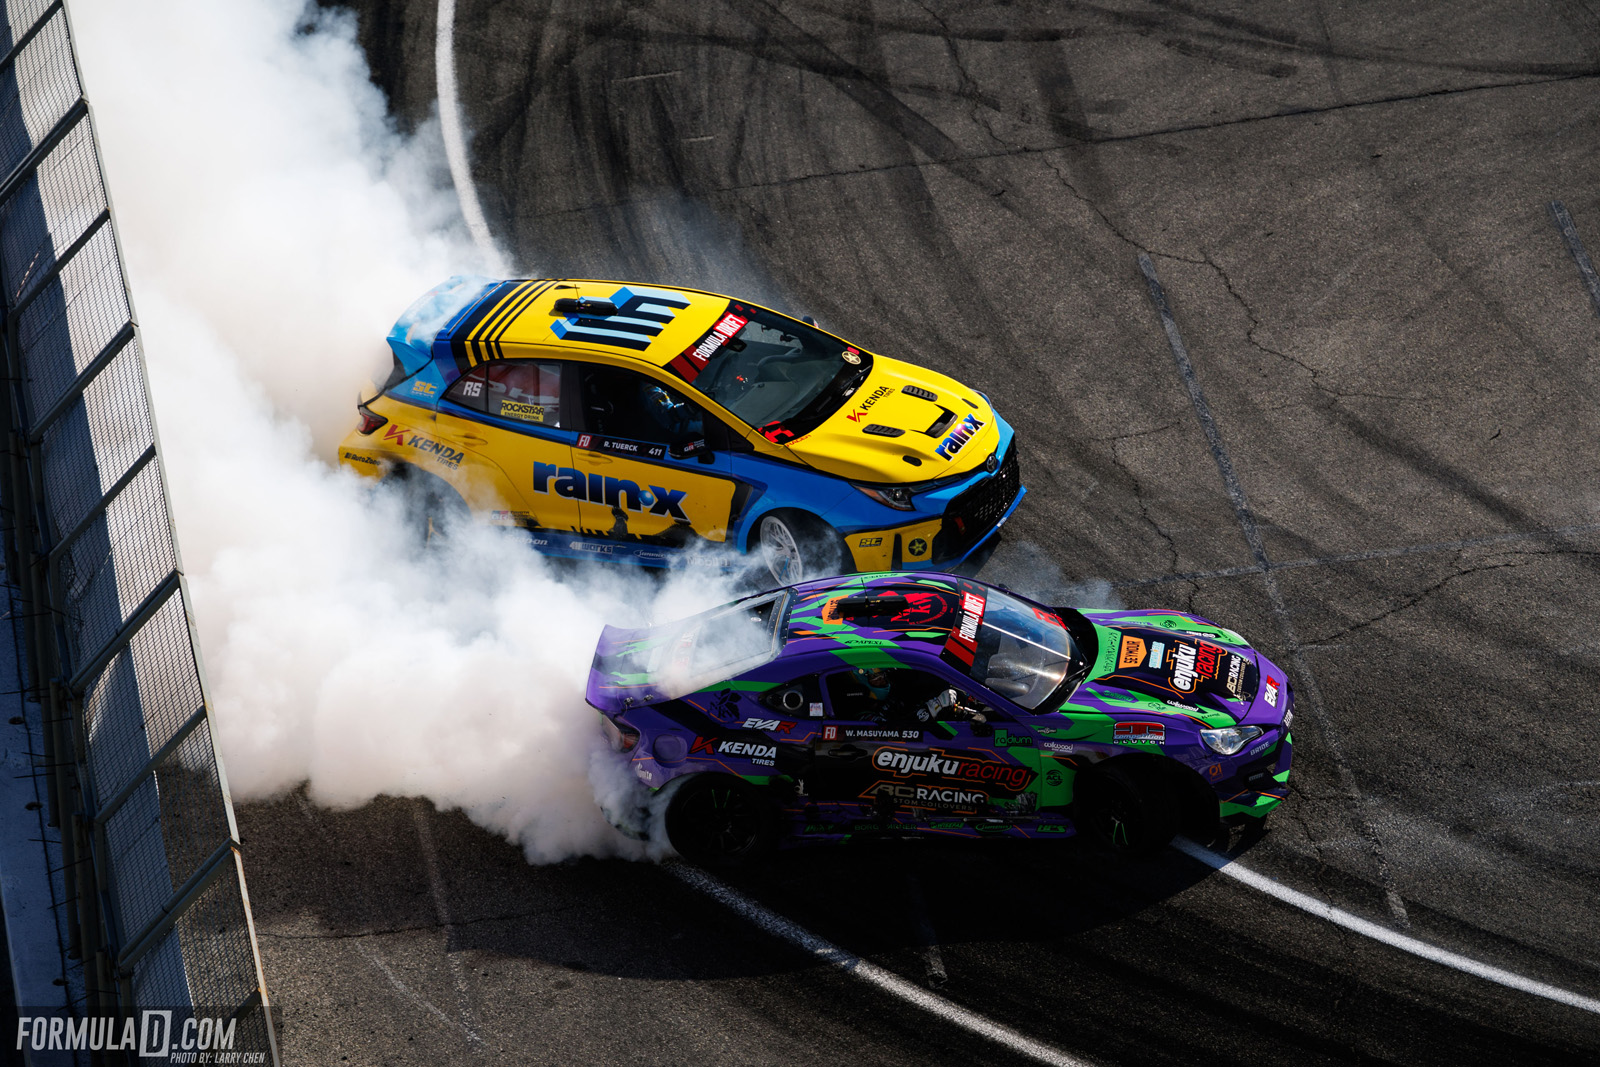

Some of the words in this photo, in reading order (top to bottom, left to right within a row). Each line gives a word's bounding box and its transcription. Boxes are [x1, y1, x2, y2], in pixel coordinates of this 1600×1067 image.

[692, 331, 728, 362] FORMULA
[715, 313, 745, 337] DRIFT
[463, 381, 483, 397] RS
[860, 386, 890, 411] KENDA
[501, 402, 545, 416] ROCKSTAR
[504, 412, 523, 420] ENERGY
[578, 434, 591, 447] FD
[407, 435, 465, 465] KENDA
[611, 442, 638, 452] TUERCK
[648, 447, 662, 456] 411
[436, 456, 459, 470] TIRES
[962, 592, 985, 615] DRIFT
[958, 611, 980, 643] FORMULA
[1124, 640, 1141, 664] SEYMOUR
[1195, 640, 1224, 678] racing
[1172, 643, 1197, 691] enjuku
[1229, 654, 1242, 679] RACING
[1226, 676, 1239, 693] BC
[824, 726, 838, 739] FD
[845, 729, 855, 738] W.
[856, 729, 900, 738] MASUYAMA
[901, 730, 920, 739] 530
[717, 740, 777, 759] KENDA
[1250, 741, 1270, 756] BRIDE
[751, 758, 776, 767] TIRES
[916, 788, 985, 804] RACING
[920, 800, 973, 811] COILOVERS
